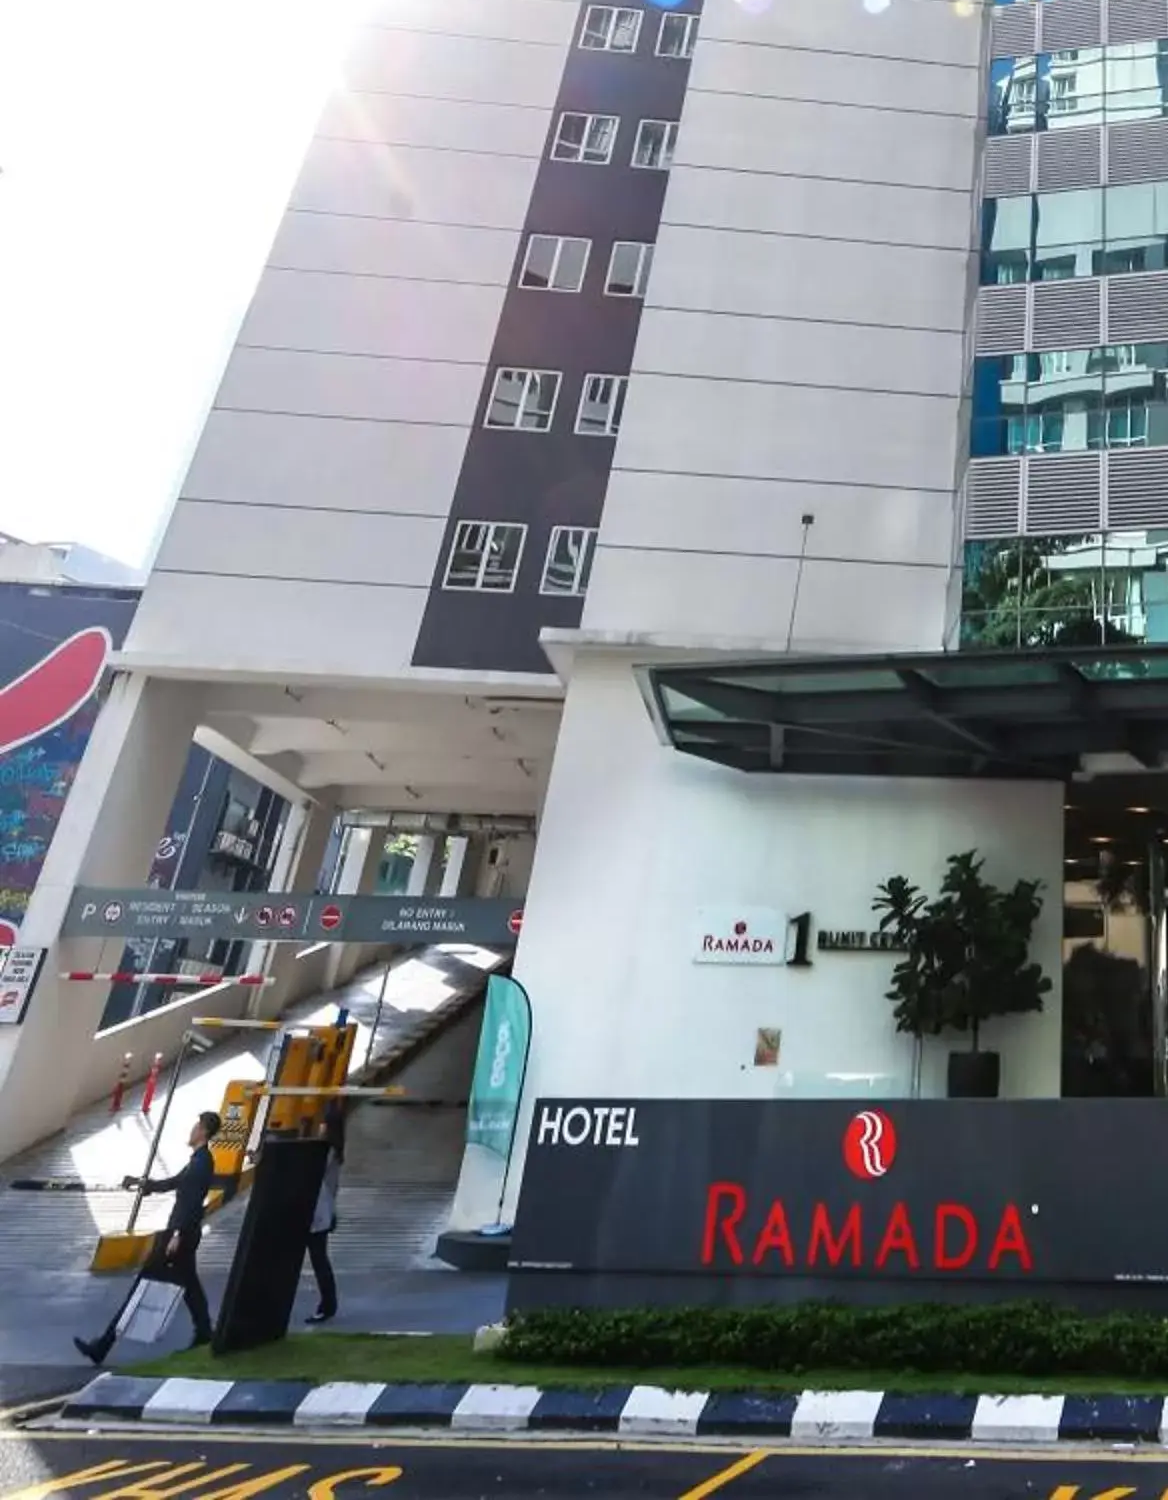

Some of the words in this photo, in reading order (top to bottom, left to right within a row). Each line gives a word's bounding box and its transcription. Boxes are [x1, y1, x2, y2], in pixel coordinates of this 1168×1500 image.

[416, 907, 447, 918] ENTRY
[702, 934, 774, 953] RAMADA
[786, 911, 814, 967] 1
[537, 1106, 640, 1146] HOTEL
